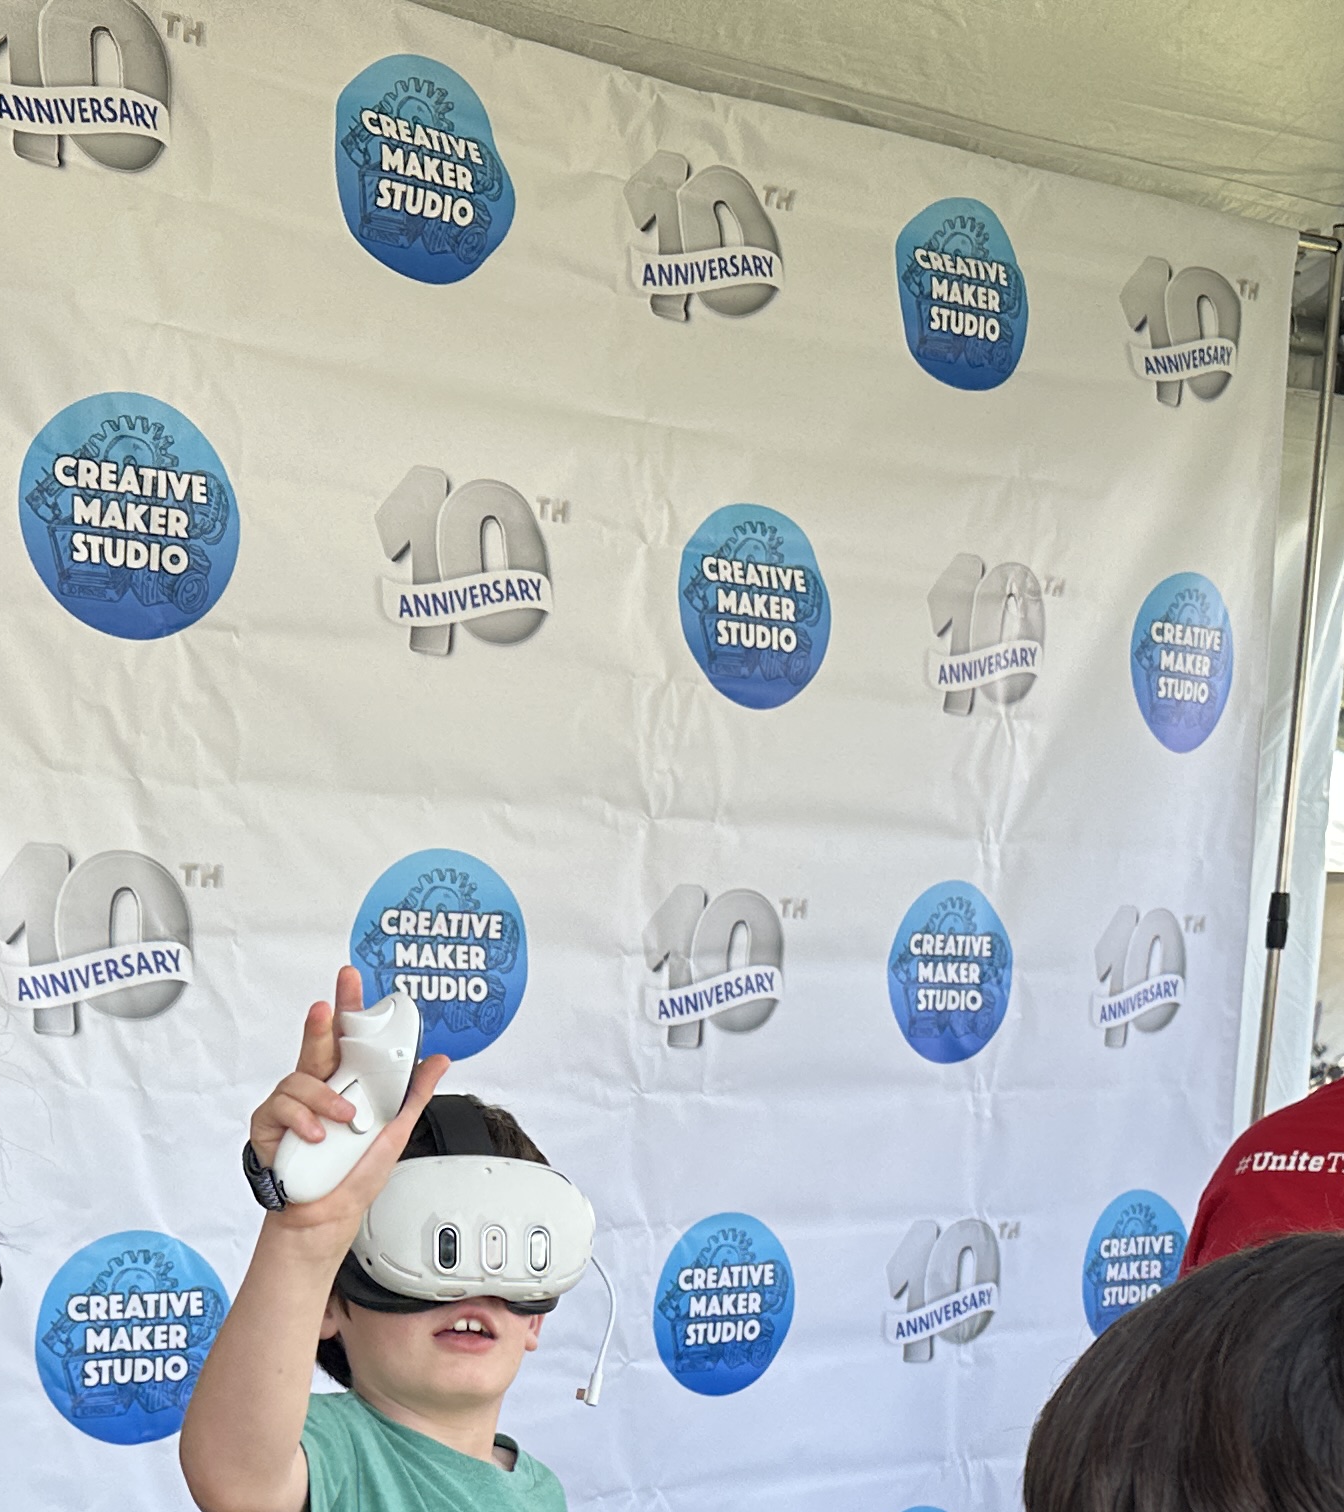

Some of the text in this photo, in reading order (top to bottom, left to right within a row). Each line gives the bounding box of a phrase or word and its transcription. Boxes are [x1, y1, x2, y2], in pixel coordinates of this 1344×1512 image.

[360, 109, 483, 165] CREATIVE
[380, 143, 474, 193] MAKER
[376, 179, 474, 227] STUDIO
[642, 255, 773, 286] ANNIVERSARY
[914, 249, 1008, 286] CREATIVE
[932, 276, 1000, 312] MAKER
[930, 307, 1000, 342] STUDIO
[1144, 345, 1233, 375] ANNIVERSARY
[54, 455, 207, 504] CREATIVE
[73, 496, 189, 538] MAKER
[72, 533, 189, 574] STUDIO
[702, 556, 806, 593] CREATIVE
[399, 579, 541, 618] ANNIVERSARY
[717, 589, 795, 622] MAKER
[716, 620, 797, 653] STUDIO
[1151, 621, 1221, 651] CREATIVE
[938, 647, 1037, 685] ANNIVERSARY
[1159, 650, 1210, 677] MAKER
[1158, 677, 1209, 704] STUDIO
[380, 909, 502, 939] CREATIVE
[395, 942, 486, 970] MAKER
[910, 933, 992, 957] CREATIVE
[18, 949, 180, 1001] ANNIVERSARY
[918, 961, 980, 984] MAKER
[394, 975, 487, 1002] STUDIO
[658, 972, 774, 1020] ANNIVERSARY
[917, 989, 982, 1011] STUDIO
[1100, 979, 1179, 1023] ANNIVERSARY
[1100, 1235, 1173, 1258] CREATIVE
[678, 1264, 774, 1291] CREATIVE
[1106, 1260, 1162, 1282] MAKER
[67, 1291, 204, 1322] CREATIVE
[689, 1292, 761, 1318] MAKER
[1102, 1284, 1162, 1307] STUDIO
[896, 1287, 993, 1340] ANNIVERSARY
[86, 1324, 188, 1354] MAKER
[685, 1319, 760, 1346] STUDIO
[83, 1355, 188, 1387] STUDIO
